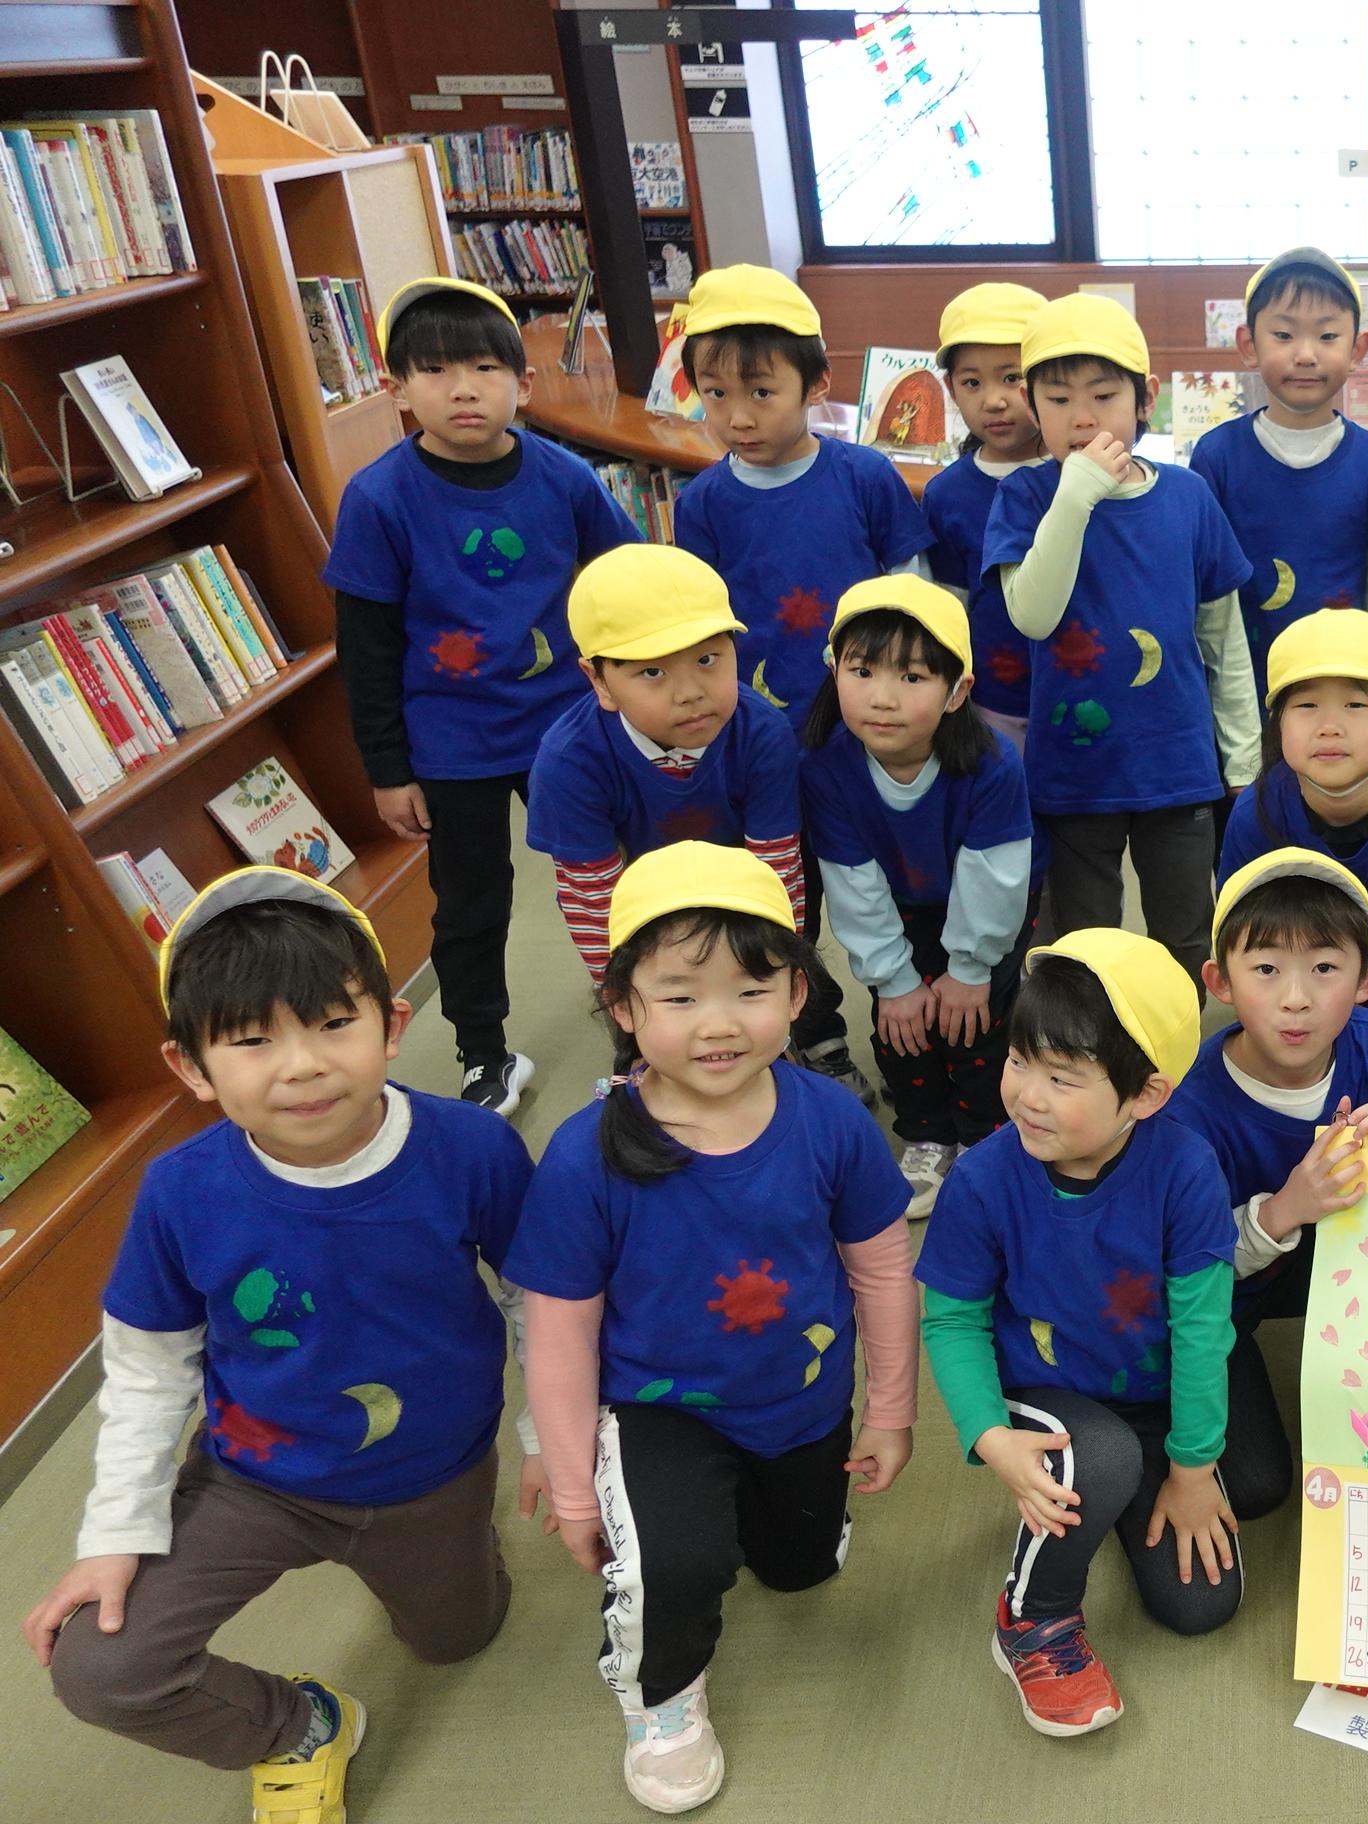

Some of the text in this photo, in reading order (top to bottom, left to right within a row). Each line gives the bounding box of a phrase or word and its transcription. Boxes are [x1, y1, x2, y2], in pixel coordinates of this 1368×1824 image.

[1349, 160, 1358, 172] P
[1306, 1475, 1337, 1502] 4月
[1350, 1489, 1363, 1499] にち
[1353, 1546, 1362, 1560] 5
[1351, 1577, 1362, 1592] 12
[1349, 1616, 1362, 1631] 19
[1348, 1647, 1363, 1667] 26
